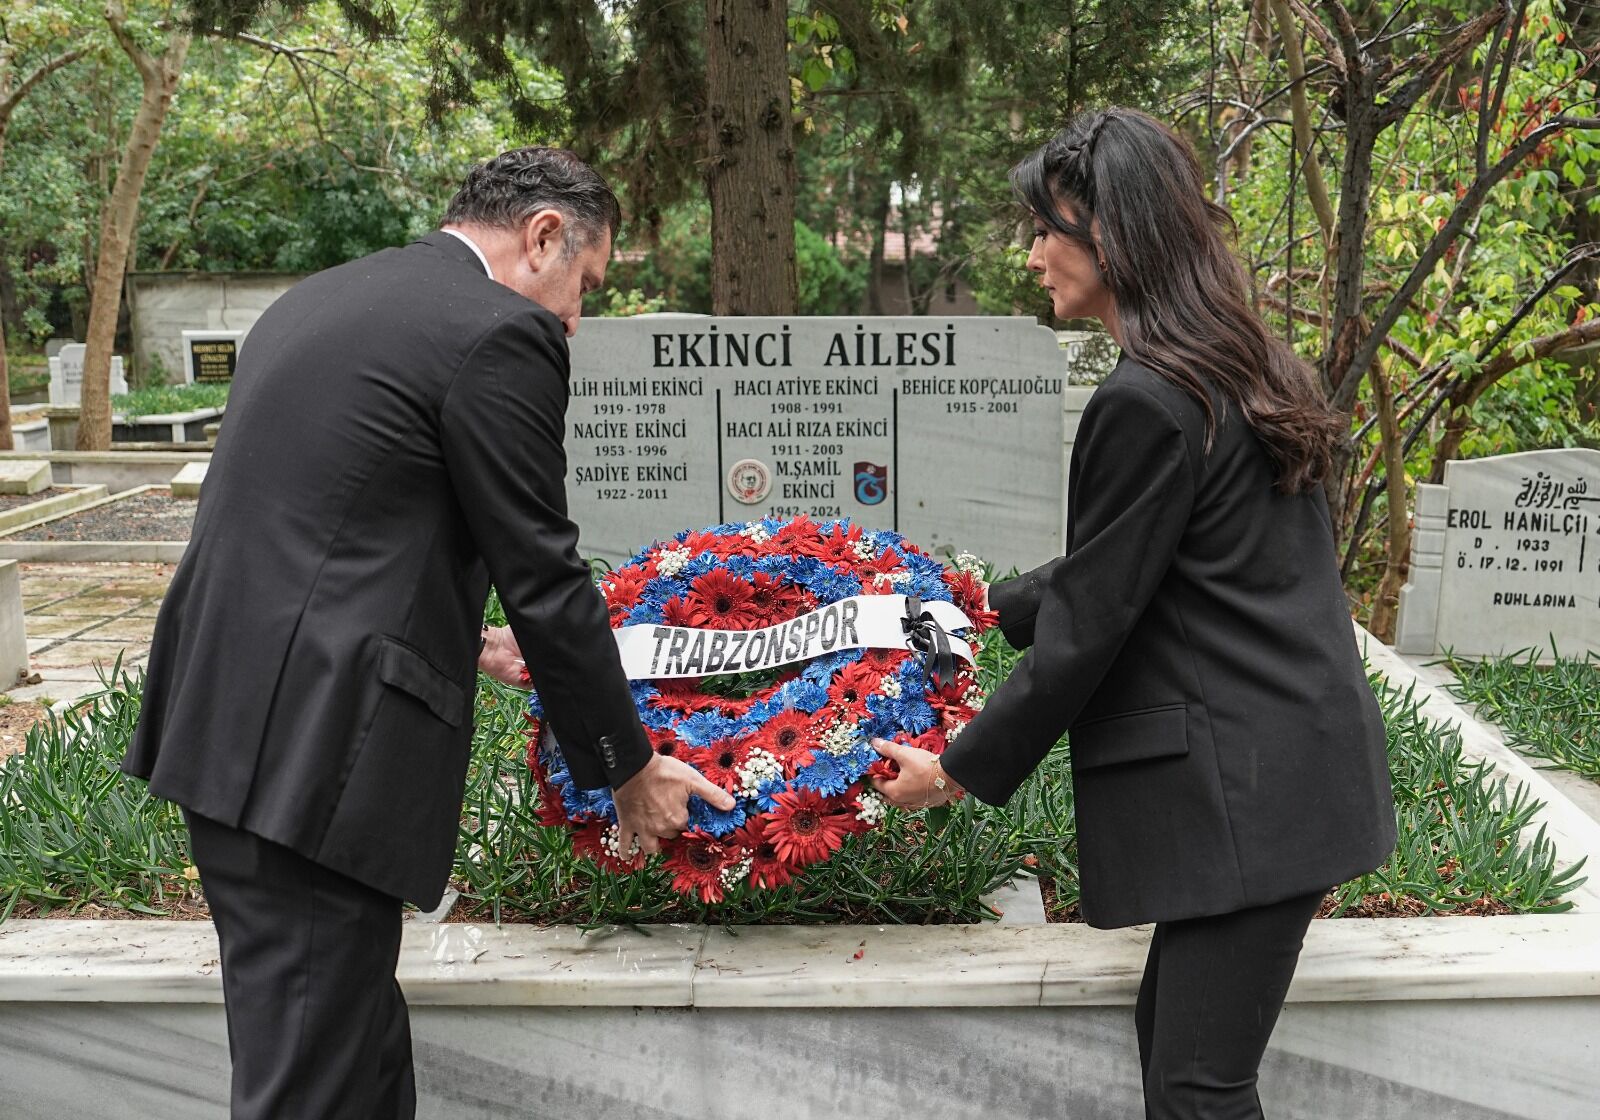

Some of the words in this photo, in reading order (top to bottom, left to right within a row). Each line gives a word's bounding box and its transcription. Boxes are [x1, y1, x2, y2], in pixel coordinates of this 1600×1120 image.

[652, 324, 792, 367] EKİNCİ
[824, 324, 956, 366] AİLESİ
[568, 377, 598, 396] LİH
[603, 377, 647, 396] HİLMİ
[652, 377, 703, 396] EKİNCİ
[734, 380, 771, 396] HACI
[776, 376, 821, 395] ATİYE
[826, 376, 878, 395] EKİNCİ
[902, 376, 955, 395] BEHİCE
[960, 376, 1062, 398] KOPÇALIOĞLU
[594, 404, 623, 415] 1919
[636, 404, 665, 414] 1978
[771, 403, 801, 414] 1908
[813, 403, 842, 413] 1991
[947, 402, 976, 413] 1915
[988, 402, 1017, 413] 2001
[574, 420, 627, 439] NACİYE
[636, 419, 686, 438] EKİNCİ
[727, 422, 762, 437] HACI
[767, 418, 791, 437] ALİ
[796, 422, 832, 437] RIZA
[836, 418, 887, 437] EKİNCİ
[596, 446, 625, 456] 1953
[637, 445, 667, 456] 1996
[772, 445, 800, 455] 1911
[813, 445, 843, 455] 2003
[576, 463, 629, 486] ŞADİYE
[637, 462, 687, 481] EKİNCİ
[597, 489, 626, 499] 1922
[638, 489, 667, 499] 2011
[783, 480, 834, 498] EKİNCİ
[768, 506, 799, 517] 1942
[811, 506, 840, 517] 2024
[1447, 509, 1492, 529] EROL
[1517, 539, 1549, 552] 1933
[1493, 592, 1575, 608] RUHLARINA
[651, 600, 859, 675] TRABZONSPOR
